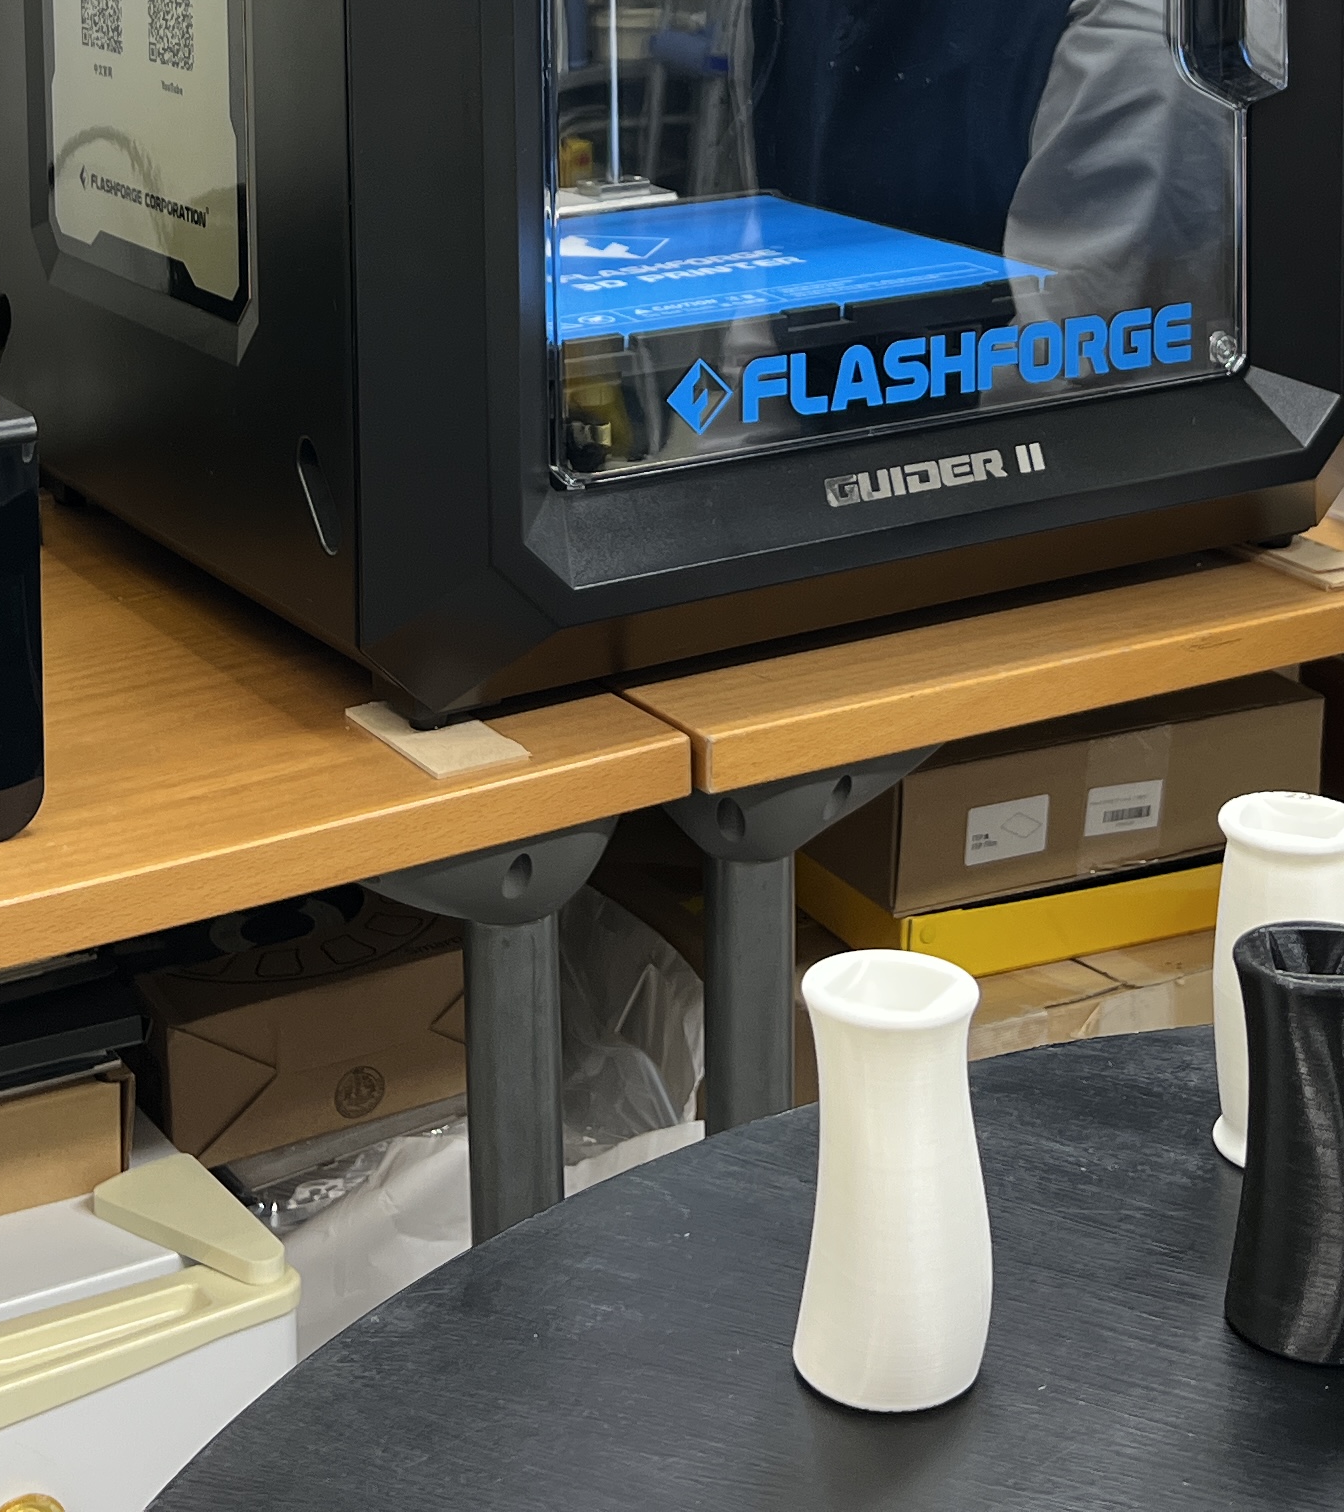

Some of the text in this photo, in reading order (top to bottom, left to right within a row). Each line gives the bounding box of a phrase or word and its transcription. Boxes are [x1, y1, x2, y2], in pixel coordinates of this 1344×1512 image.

[90, 173, 207, 228] FLASHFORGE CORPORATION
[636, 256, 807, 283] PRINTER
[742, 302, 1193, 423] FLASHFORGE
[824, 442, 1046, 508] GUIDER II
